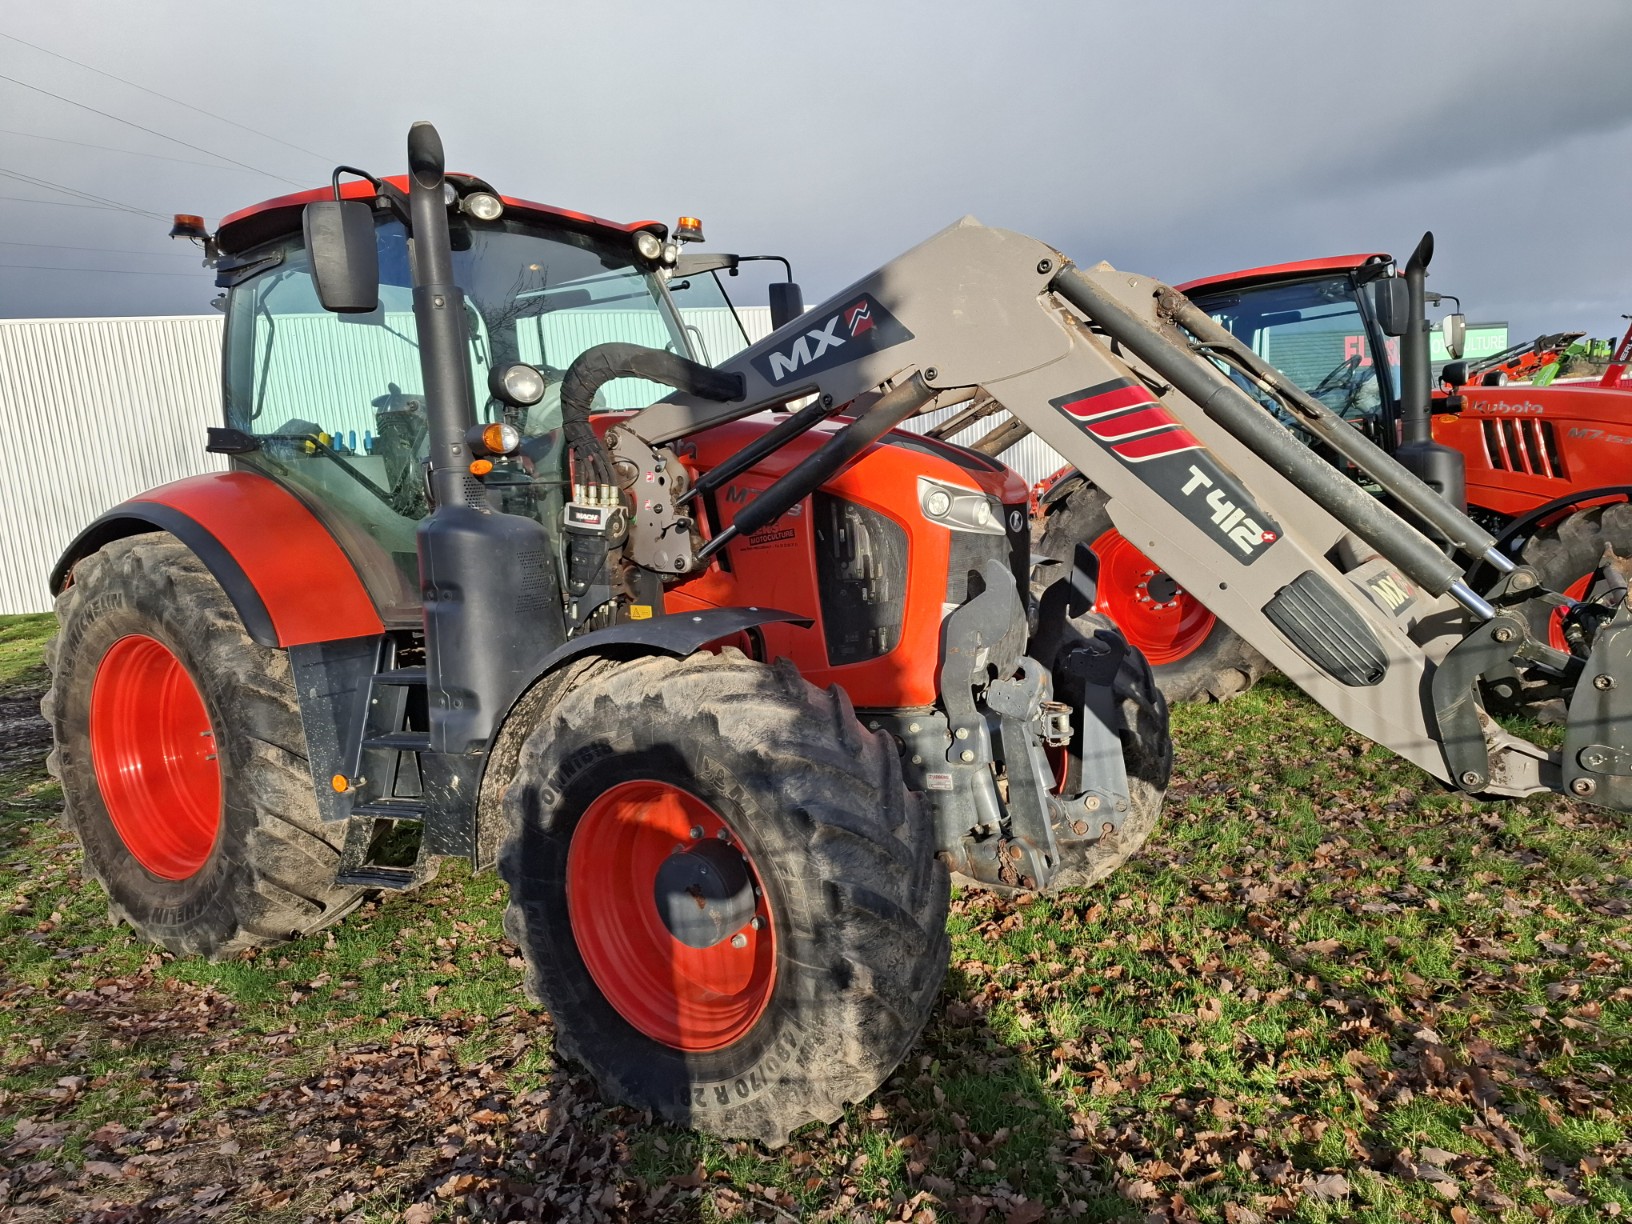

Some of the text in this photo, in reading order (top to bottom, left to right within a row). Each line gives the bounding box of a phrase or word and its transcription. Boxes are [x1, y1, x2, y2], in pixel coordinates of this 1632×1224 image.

[769, 315, 846, 381] MX
[1432, 336, 1506, 353] OTULTURE
[1472, 400, 1544, 414] Kubota
[750, 530, 794, 544] MOTOCULTURE
[1370, 575, 1409, 610] MX
[541, 737, 614, 806] OMNIBIB
[734, 1029, 799, 1100] 480/70
[713, 1085, 731, 1106] R
